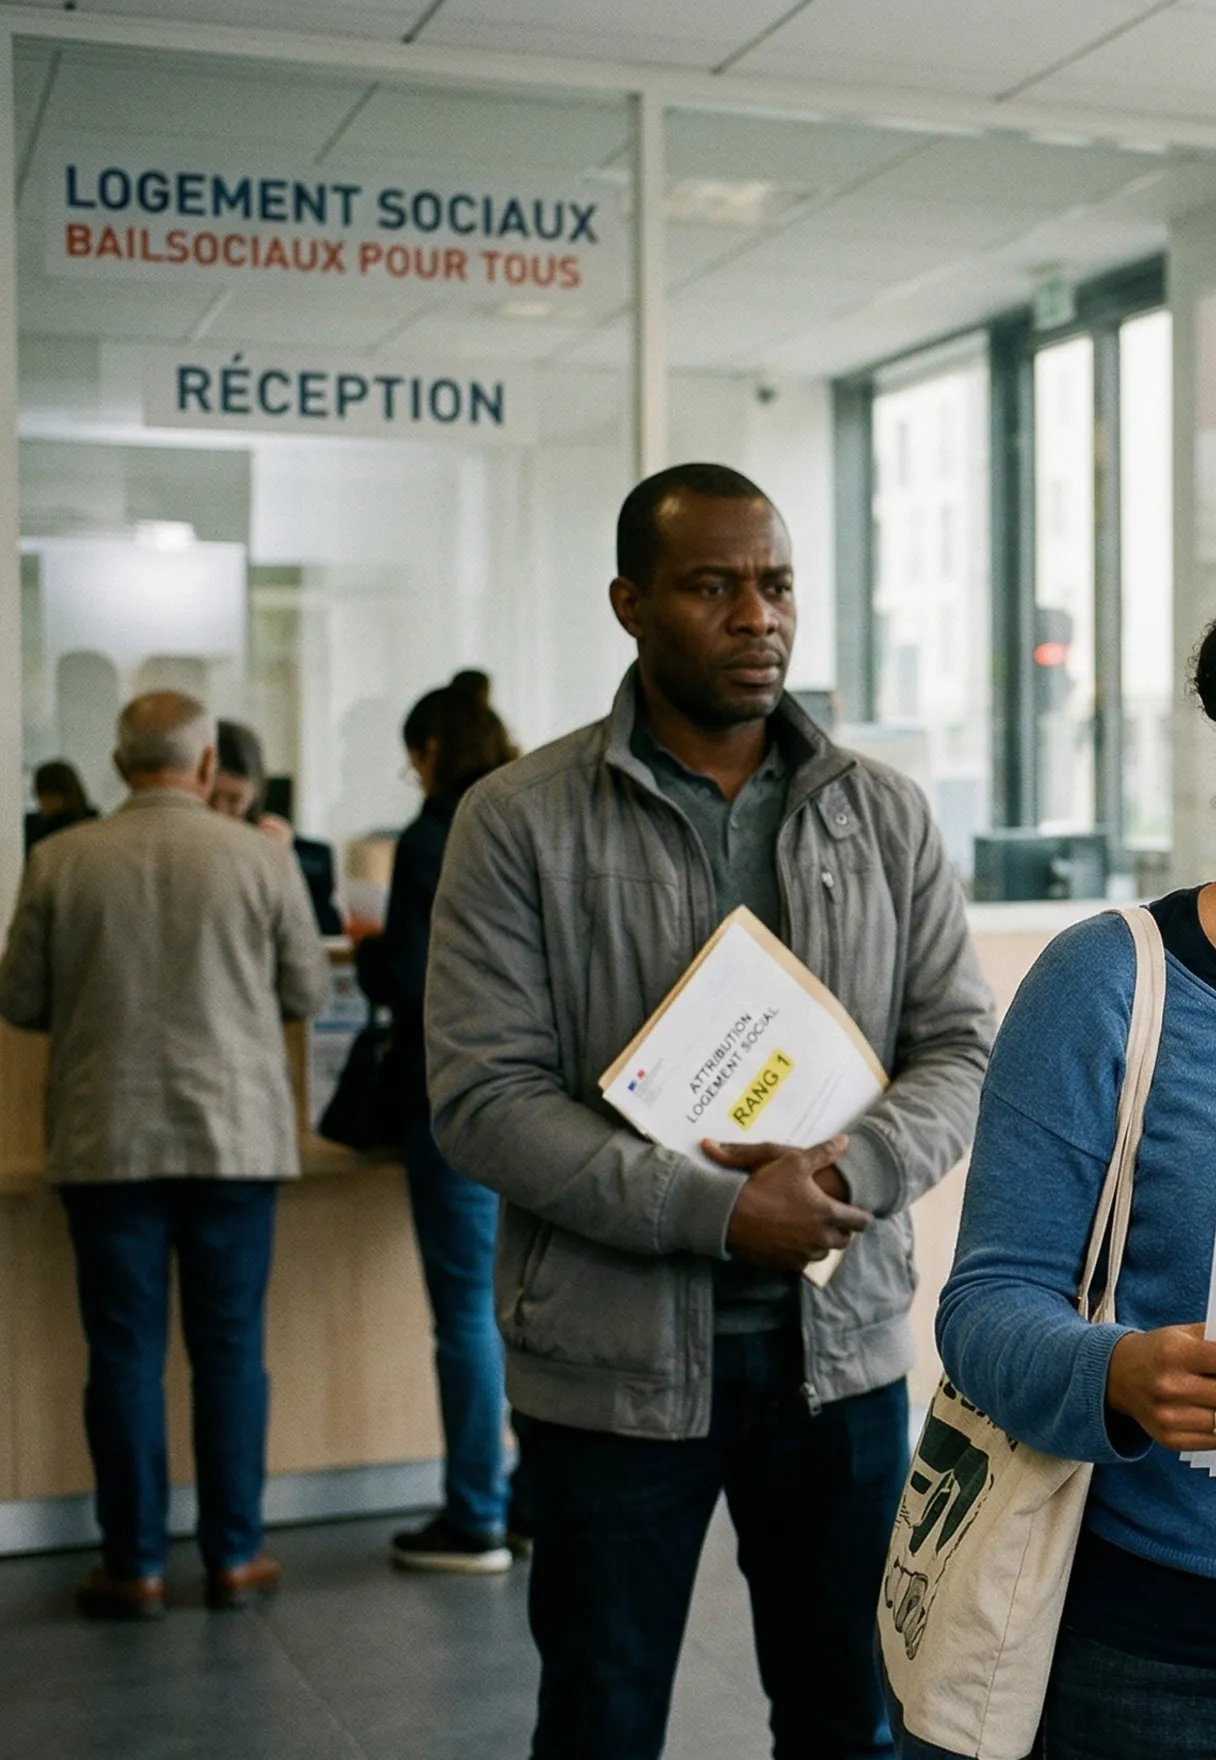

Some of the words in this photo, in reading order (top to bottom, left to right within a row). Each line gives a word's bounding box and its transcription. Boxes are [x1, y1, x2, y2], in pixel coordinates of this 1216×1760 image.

[65, 163, 362, 227] LOGEMENT
[376, 188, 598, 244] SOCIAUX
[64, 222, 346, 275] BAILSOCIAUX
[358, 242, 468, 281] POUR
[482, 249, 582, 289] TOUS
[176, 353, 506, 426] RÉCEPTION
[686, 1051, 742, 1124] LOGEMENT
[740, 1006, 780, 1054] SOCIAL
[689, 1013, 753, 1095] ATTRIBUTION
[732, 1069, 779, 1126] RANG
[776, 1054, 791, 1068] 1
